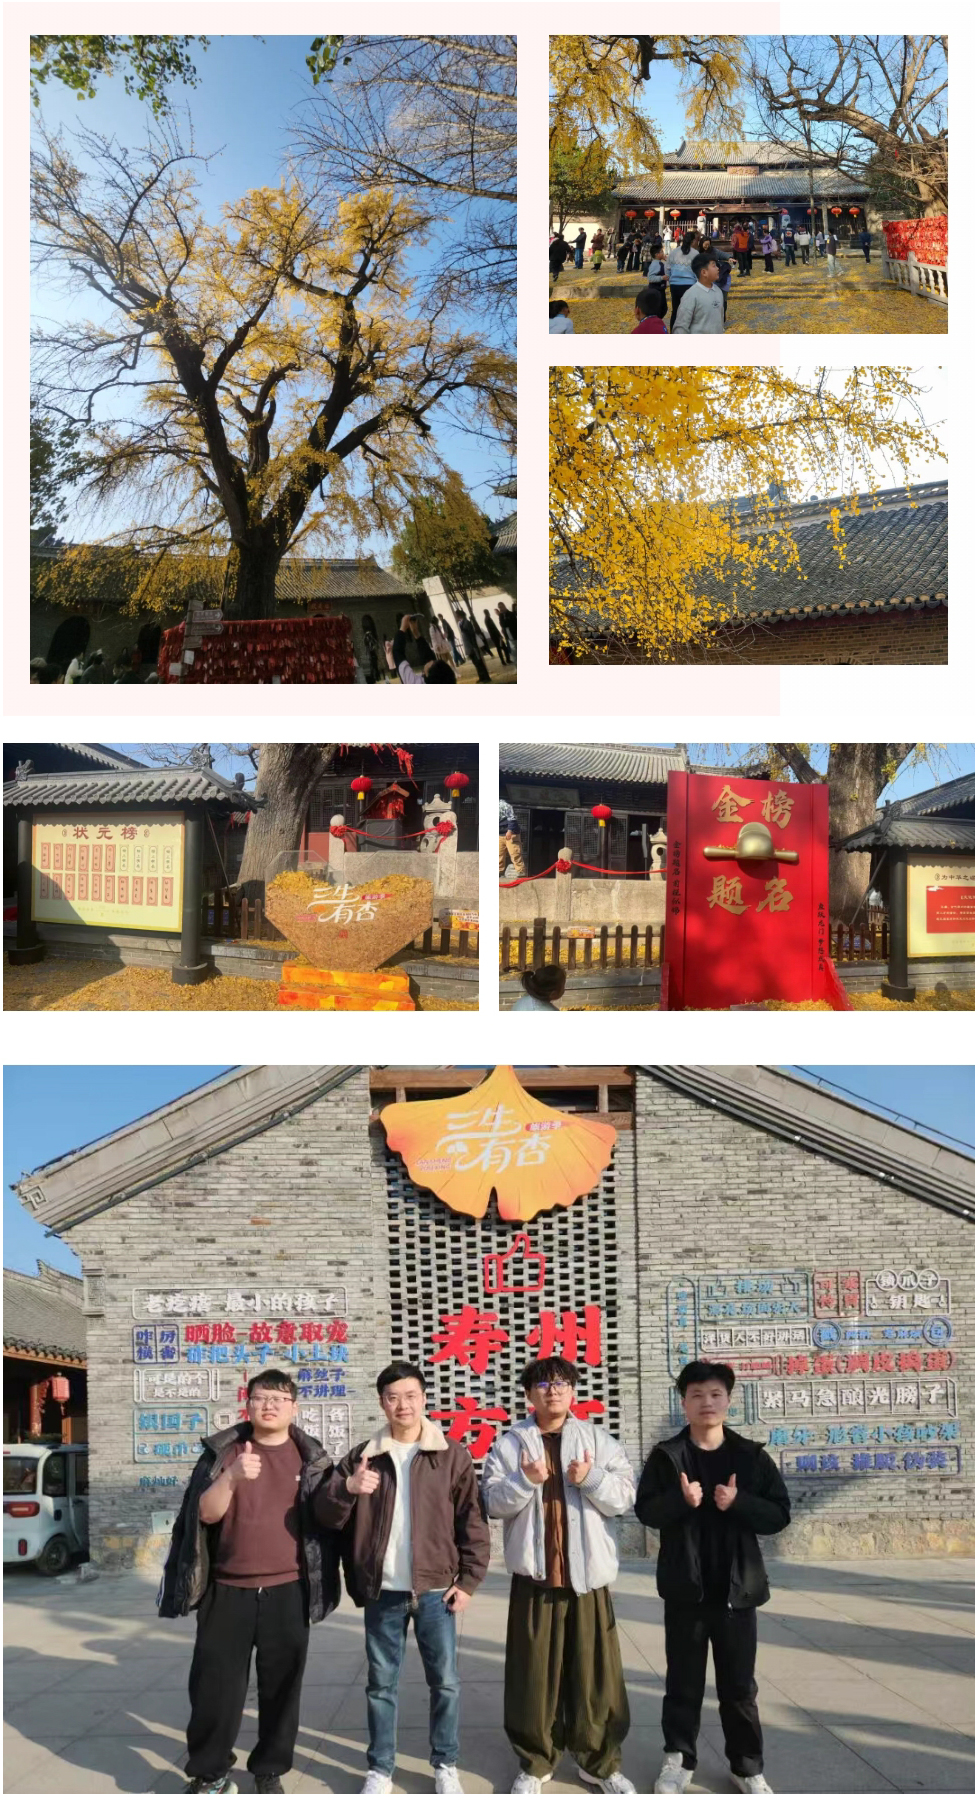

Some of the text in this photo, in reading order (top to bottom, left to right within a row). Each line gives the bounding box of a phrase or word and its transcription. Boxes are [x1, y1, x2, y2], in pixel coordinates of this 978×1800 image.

[711, 785, 794, 829] 金榜
[73, 827, 138, 841] 状元榜
[706, 874, 794, 914] 题名
[428, 1304, 603, 1375] 寿州
